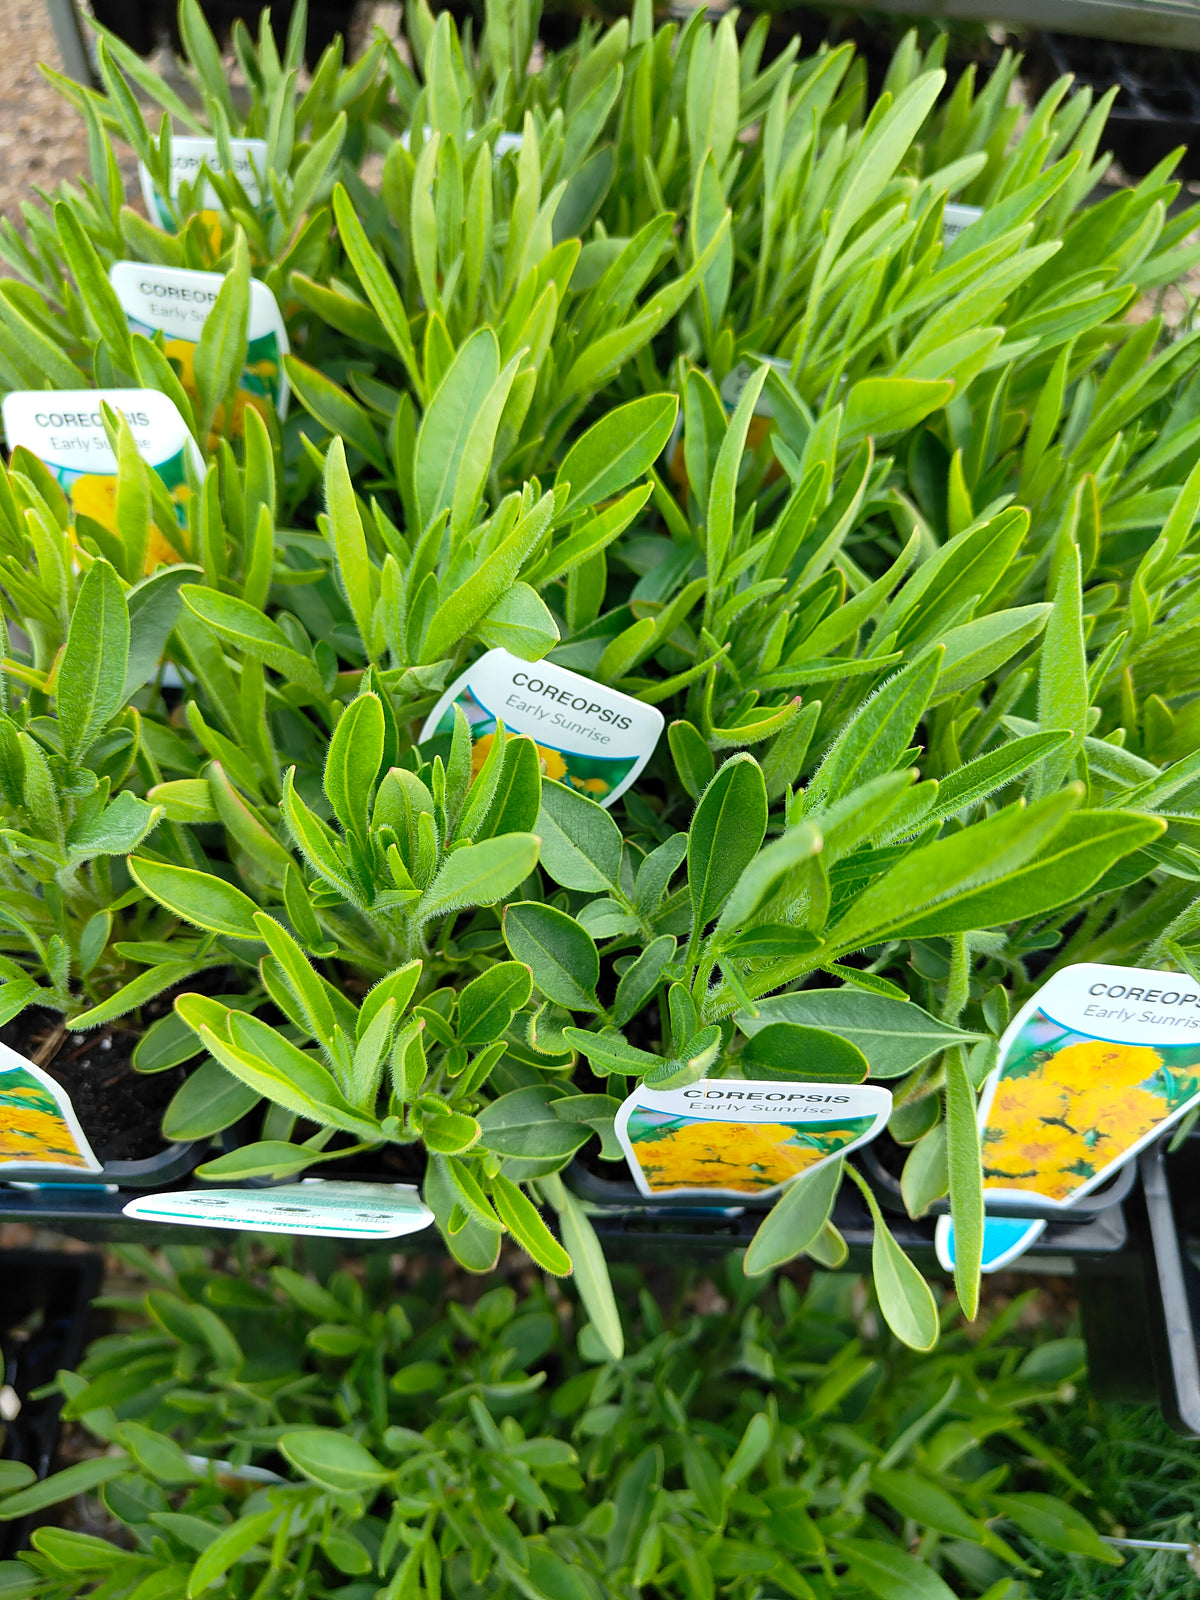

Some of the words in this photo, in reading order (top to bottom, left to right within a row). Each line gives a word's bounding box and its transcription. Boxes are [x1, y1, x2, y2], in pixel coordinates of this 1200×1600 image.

[140, 282, 218, 303] COREOP
[151, 303, 187, 321] Early
[35, 412, 150, 428] COREOIS
[50, 436, 90, 453] Early
[512, 672, 633, 730] COREOPSIS
[505, 693, 550, 720] Early
[550, 712, 611, 745] Sunrise
[1083, 1004, 1136, 1022] Early
[683, 1089, 851, 1104] COREOPSIS
[689, 1101, 746, 1113] Early
[750, 1103, 833, 1114] Sunrise
